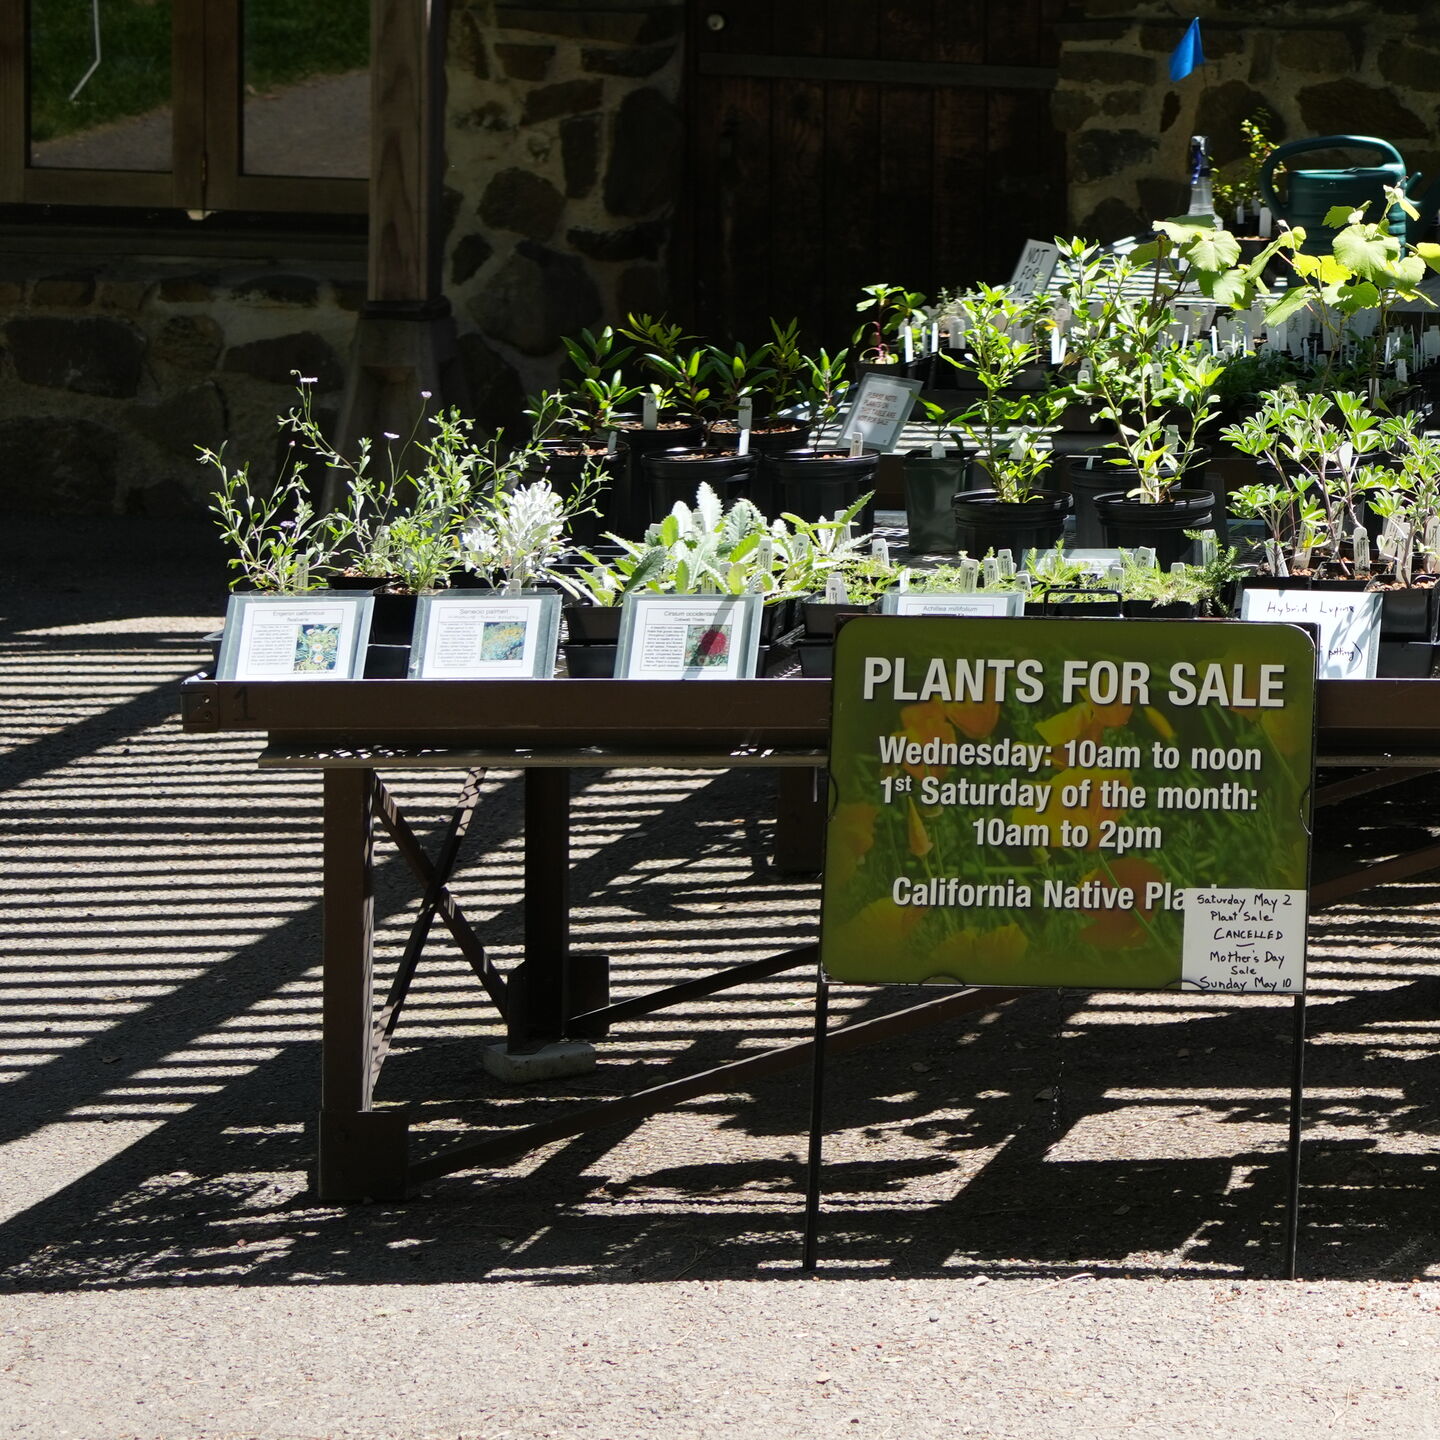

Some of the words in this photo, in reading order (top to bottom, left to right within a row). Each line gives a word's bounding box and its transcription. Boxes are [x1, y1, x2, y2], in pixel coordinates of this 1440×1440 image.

[1267, 601, 1308, 616] Hybrid
[863, 656, 1044, 704] PLANTS
[1062, 660, 1150, 706] FOR
[1168, 663, 1285, 708] SALE
[879, 736, 1052, 772] Wednesday:
[1063, 739, 1141, 768] 10am
[1152, 742, 1180, 769] to
[1190, 745, 1262, 771] noon
[880, 777, 912, 804] 1st
[921, 777, 1052, 813] Saturday
[1061, 781, 1091, 807] of
[1100, 782, 1146, 809] the
[1157, 784, 1258, 811] month:
[972, 819, 1049, 847] 10am
[1060, 822, 1089, 849] to
[1098, 821, 1162, 854] 2pm
[892, 877, 1031, 909] California
[1043, 880, 1134, 911] Native
[1197, 894, 1246, 913] Saturday
[1254, 893, 1278, 913] May
[1282, 894, 1292, 906] 2
[1210, 910, 1237, 922] Plant
[1243, 910, 1274, 922] Sale
[1213, 928, 1284, 941] CANCELLED
[1210, 950, 1260, 963] Mother's
[1264, 951, 1285, 970] Day
[1231, 966, 1257, 975] Sale
[1200, 976, 1248, 991] Sunday
[1254, 976, 1278, 992] May
[1283, 978, 1292, 988] 10
